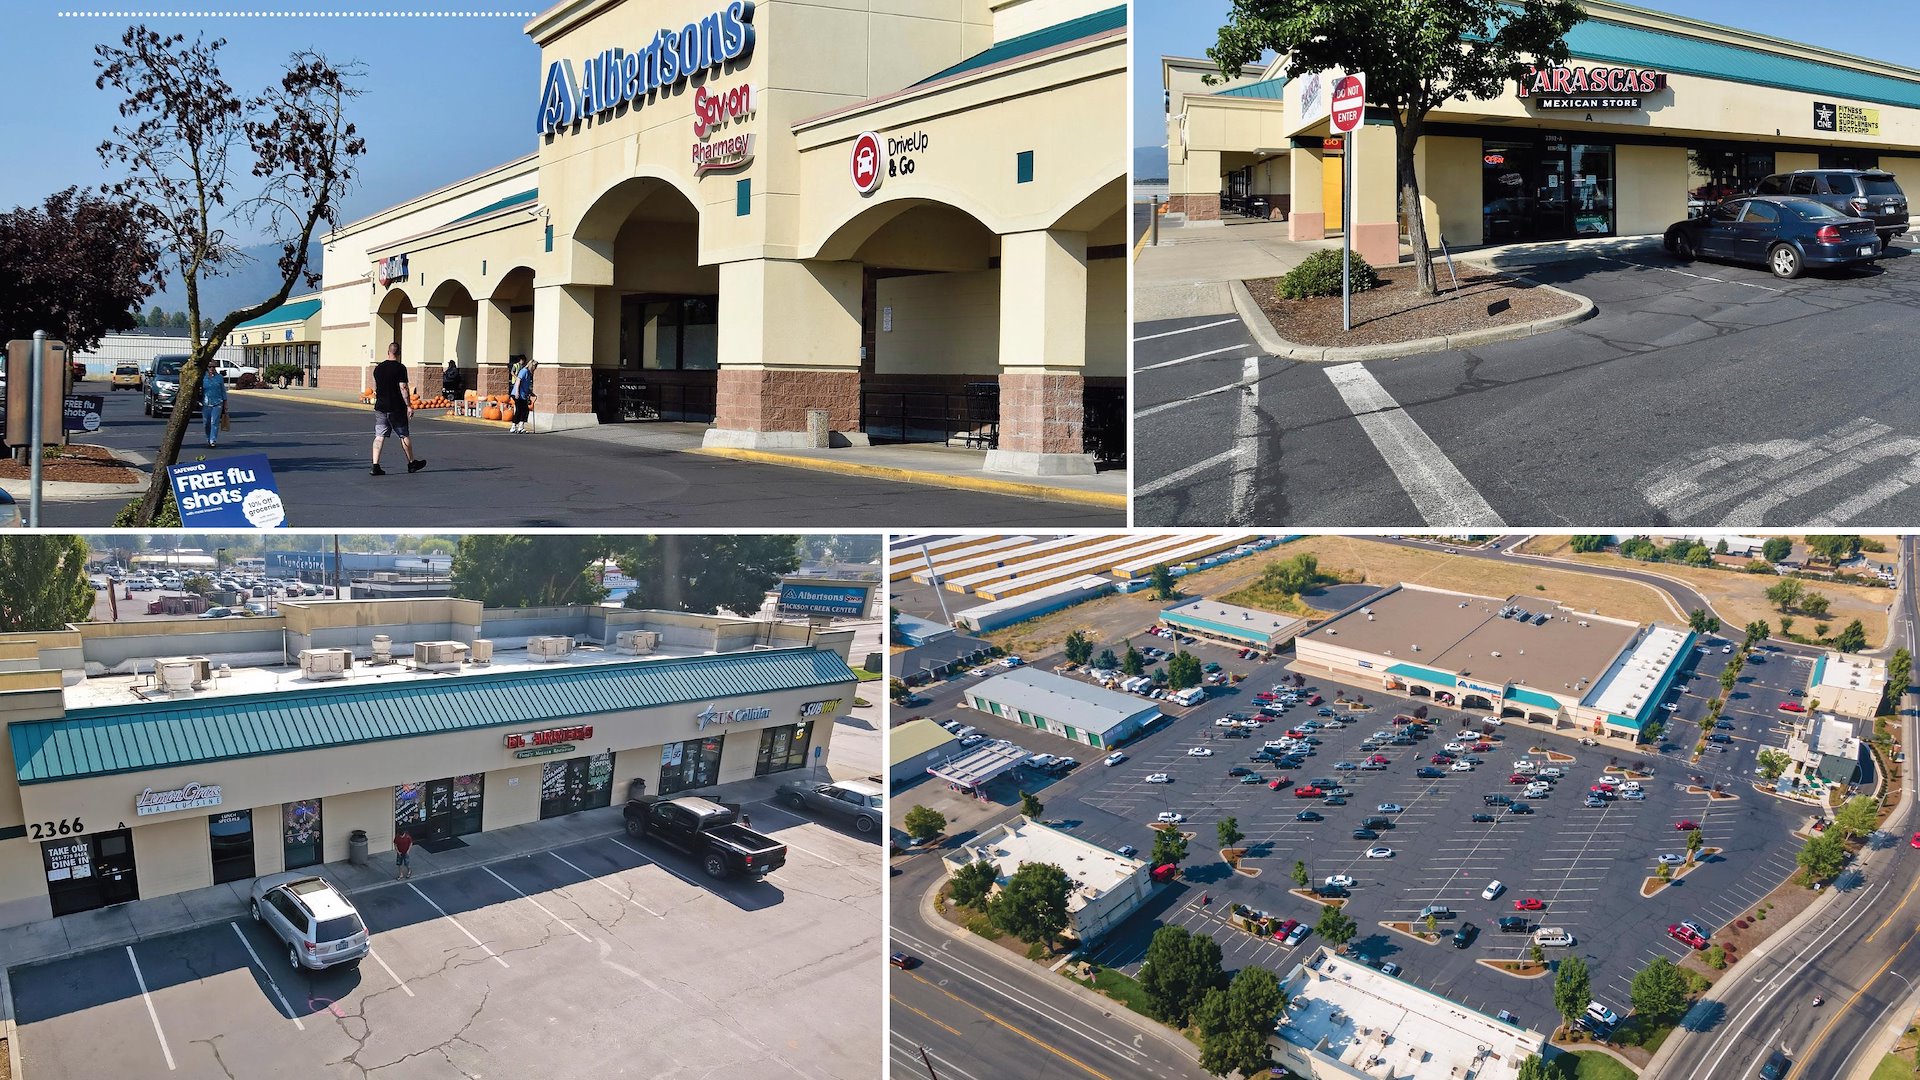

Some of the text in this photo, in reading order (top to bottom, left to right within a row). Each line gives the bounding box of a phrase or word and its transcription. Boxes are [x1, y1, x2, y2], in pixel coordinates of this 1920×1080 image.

[578, 0, 755, 120] Albertsons
[1336, 85, 1360, 99] DO NOT
[1543, 98, 1638, 108] MEXICAN STORE
[1838, 105, 1863, 115] FITNESS
[1337, 110, 1358, 123] ENTER
[1585, 113, 1593, 121] A
[1838, 112, 1867, 121] COACHING
[1817, 120, 1832, 129] ONE
[1838, 119, 1879, 129] SUPPLEMENTS
[1838, 125, 1870, 133] BOOTCAMP
[1323, 138, 1339, 146] GO
[692, 133, 750, 164] Pharmacy
[888, 155, 915, 177] & Go
[64, 400, 96, 409] FREE flu
[173, 465, 199, 475] SAFEWAY
[176, 467, 257, 493] FREE flu
[248, 500, 262, 509] 10%
[248, 503, 281, 517] groceries
[797, 591, 844, 602] Albertsons
[783, 603, 810, 611] JACKSON
[831, 606, 857, 614] CENTER
[803, 700, 842, 717] SUBWAY
[140, 799, 220, 814] THAI CUISINE
[30, 816, 84, 840] 2366
[118, 821, 126, 829] A
[48, 843, 88, 857] TAKE OUT
[52, 857, 90, 870] DINE IN
